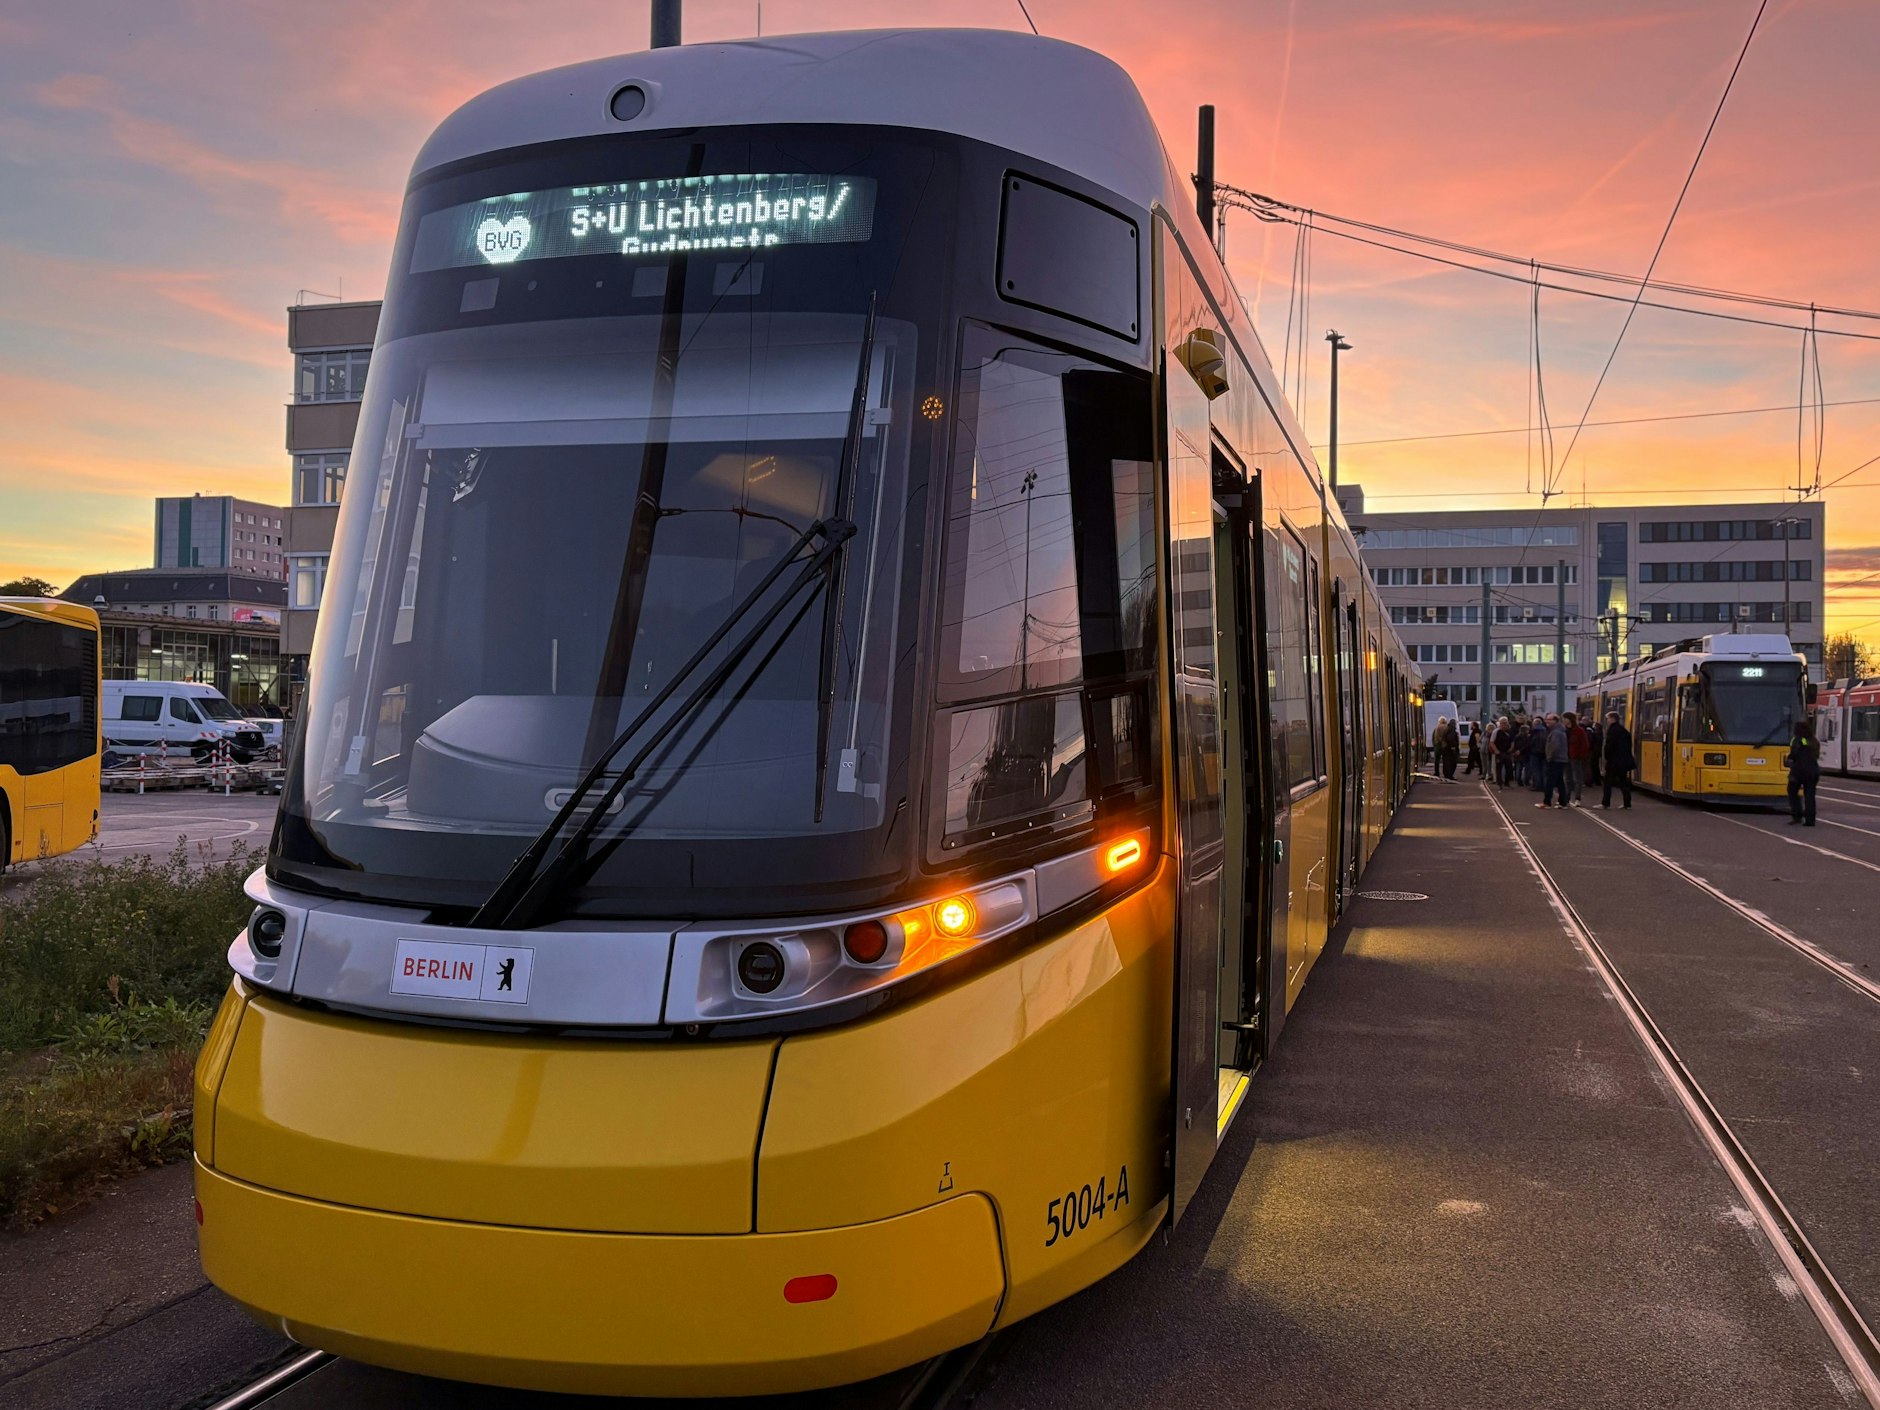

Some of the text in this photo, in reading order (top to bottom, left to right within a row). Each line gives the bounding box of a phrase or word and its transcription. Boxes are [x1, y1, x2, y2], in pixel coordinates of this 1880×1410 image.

[572, 185, 850, 236] S+U Lichtenberg/
[484, 230, 522, 252] BVG
[403, 957, 474, 981] BERLIN
[1045, 1165, 1129, 1247] 5004-A
